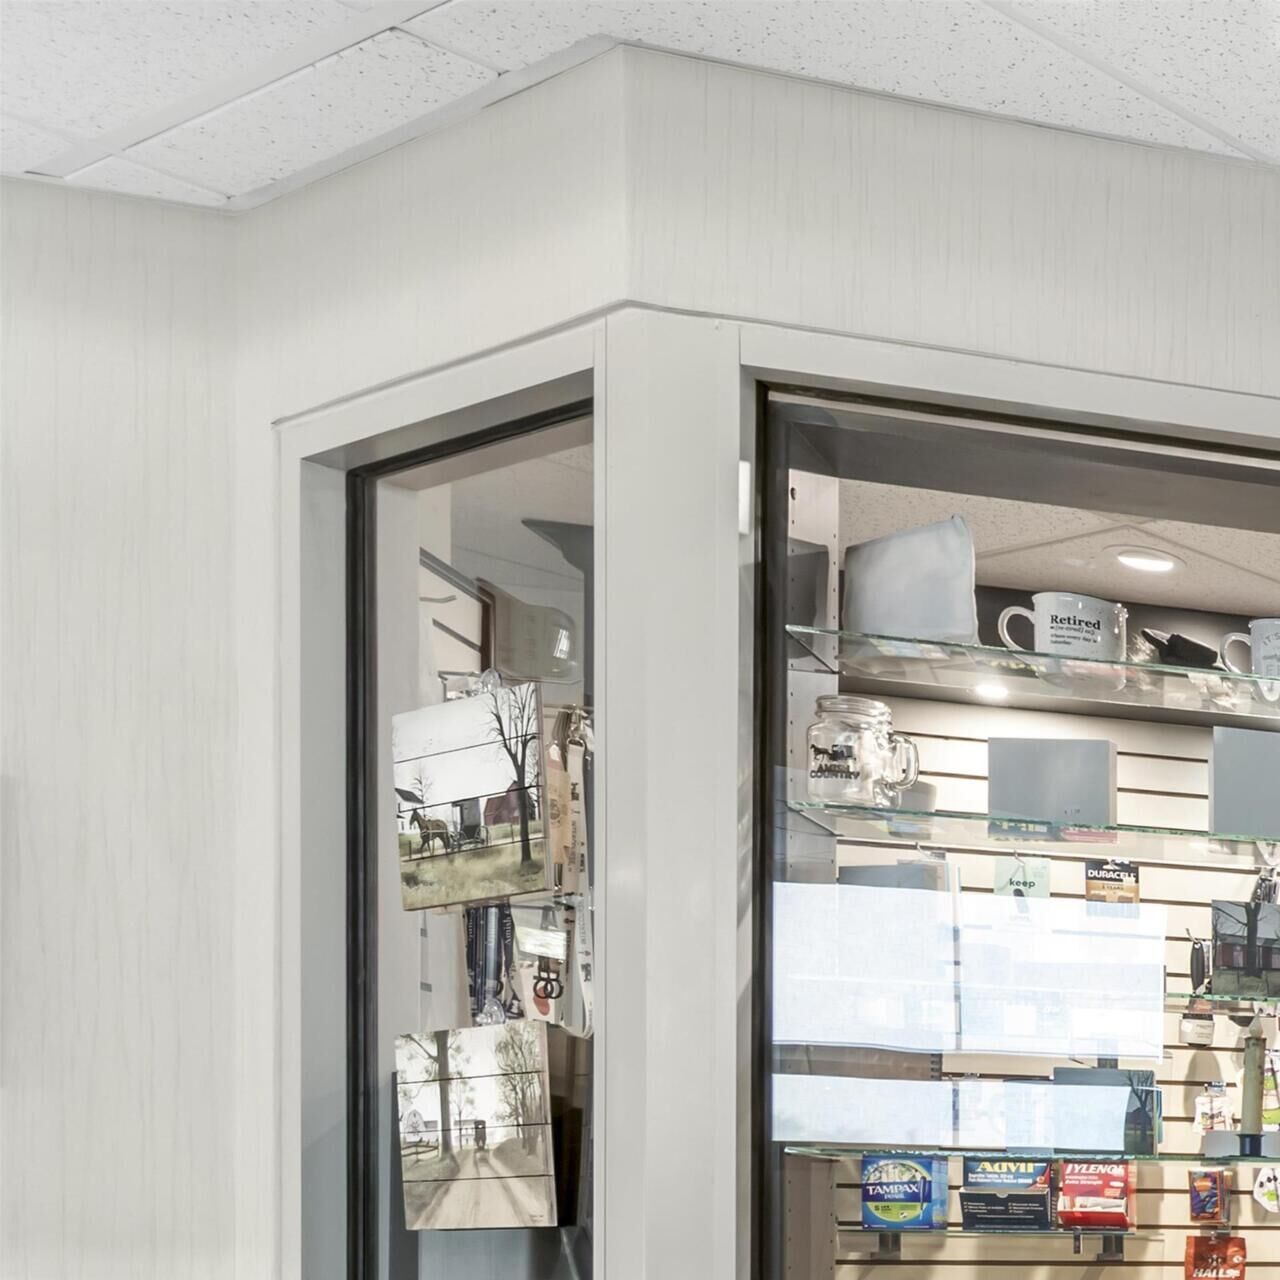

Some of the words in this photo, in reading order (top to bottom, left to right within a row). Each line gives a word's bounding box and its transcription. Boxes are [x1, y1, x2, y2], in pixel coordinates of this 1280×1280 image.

[1049, 615, 1101, 630] Retired
[1087, 869, 1137, 881] DURACELL
[1009, 878, 1035, 889] keep
[975, 1161, 1035, 1173] Advil
[866, 1184, 918, 1194] TAMPAX
